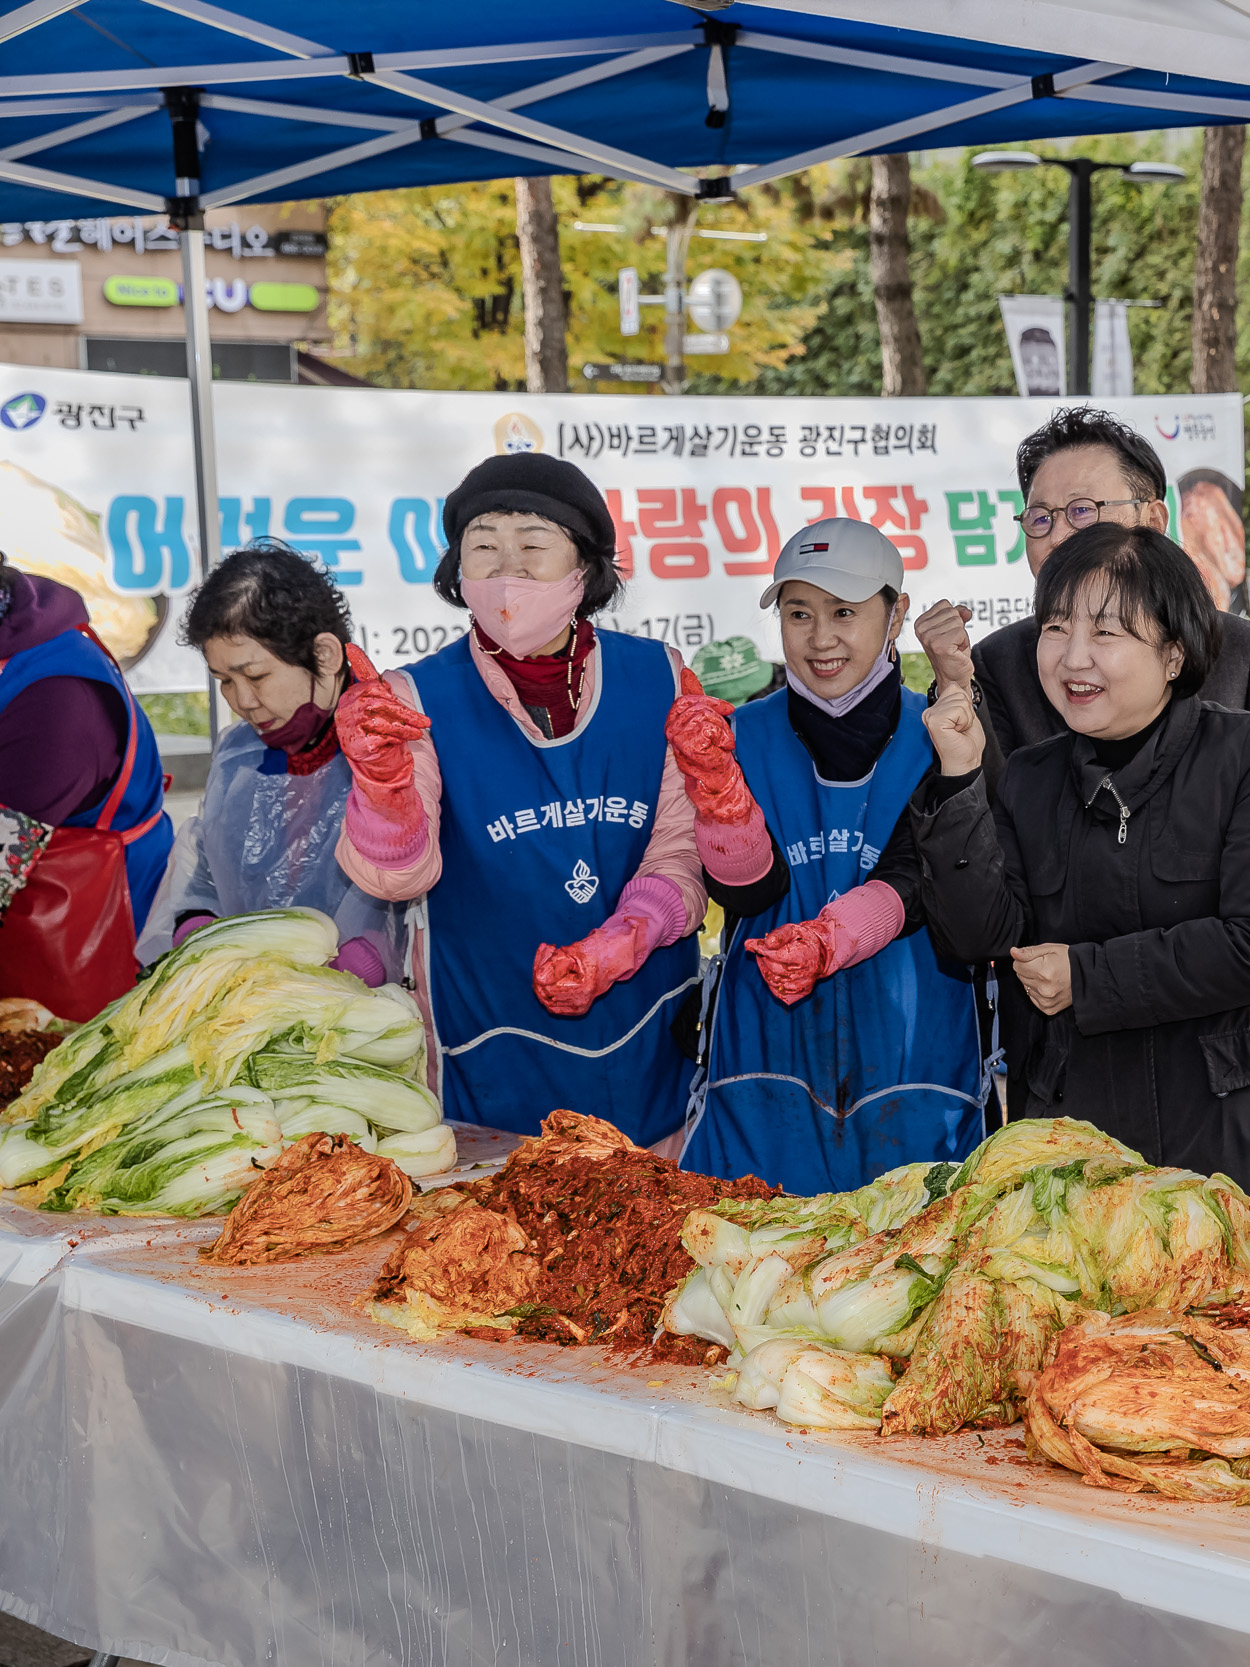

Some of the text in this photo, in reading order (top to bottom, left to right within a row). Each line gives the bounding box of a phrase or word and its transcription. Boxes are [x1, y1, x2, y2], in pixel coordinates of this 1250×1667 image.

[53, 401, 146, 431] 광진구
[558, 421, 939, 459] (사)바르게살기운동 광진구협의회
[486, 795, 649, 843] 바르게살기운동
